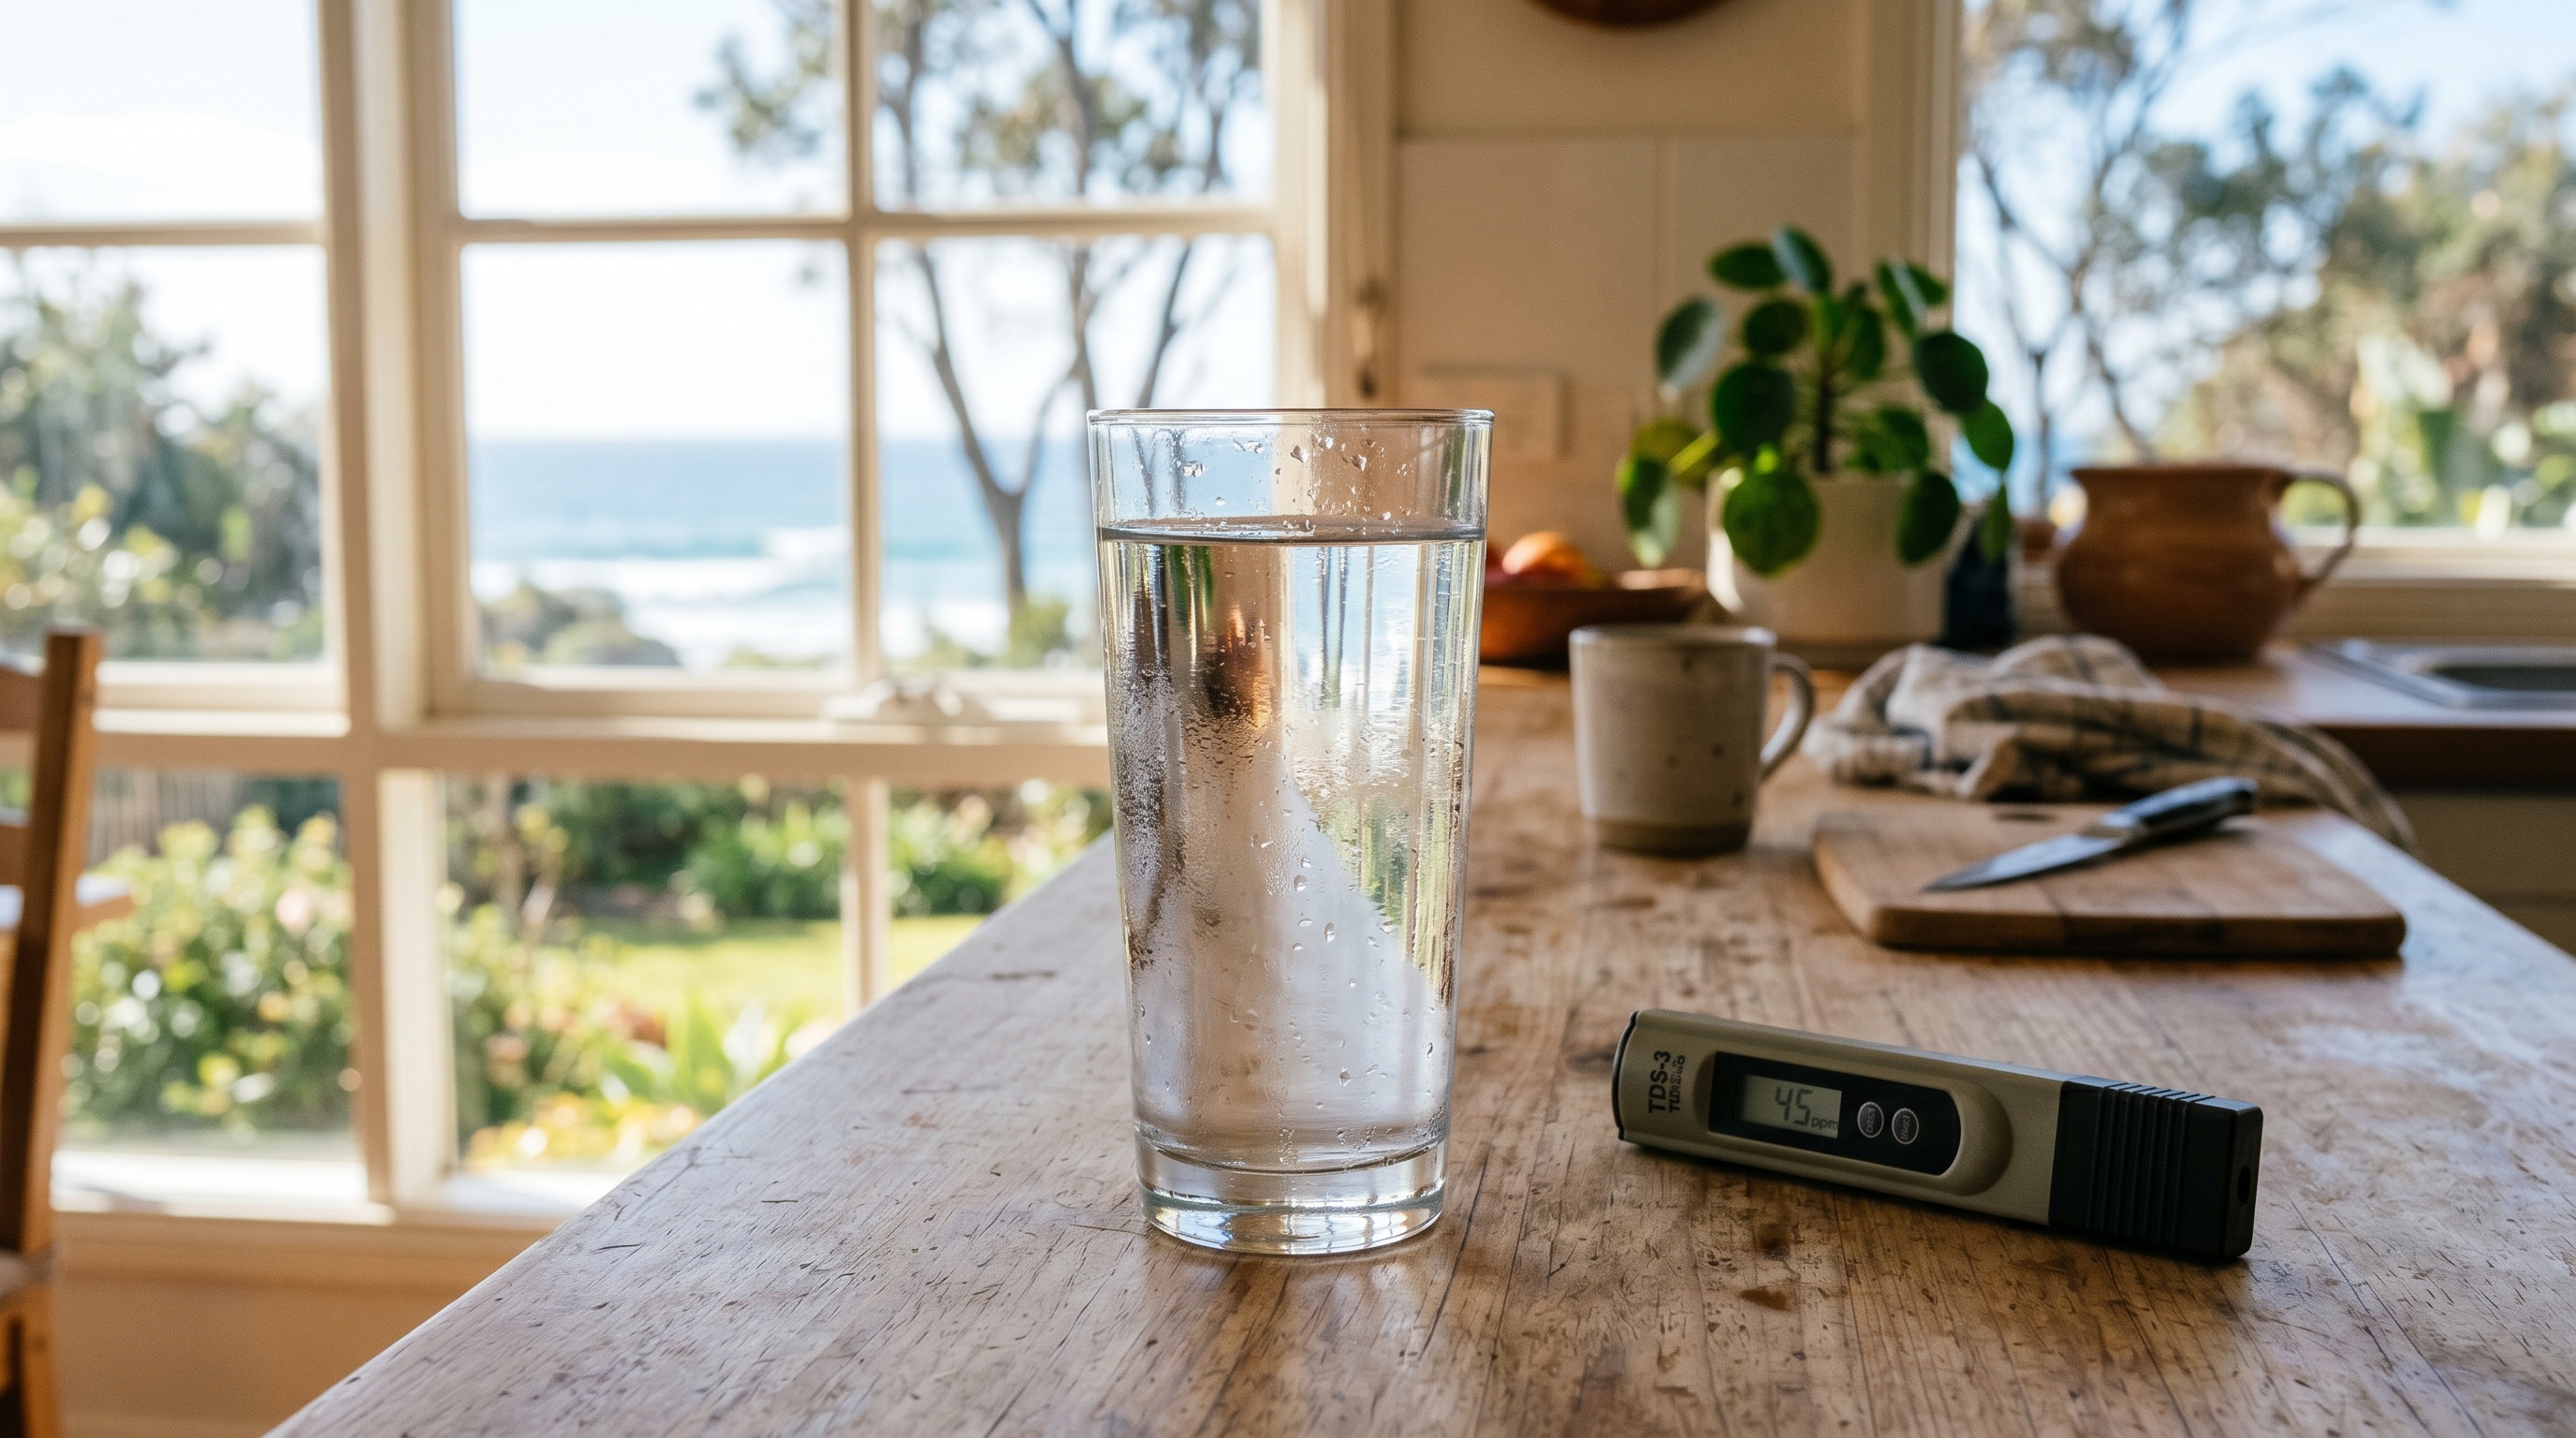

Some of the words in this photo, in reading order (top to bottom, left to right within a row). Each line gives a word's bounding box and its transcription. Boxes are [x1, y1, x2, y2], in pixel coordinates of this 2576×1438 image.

[1647, 1050, 1671, 1114] TDS-3
[1775, 1086, 1813, 1126] 45
[1811, 1117, 1838, 1130] ppm
